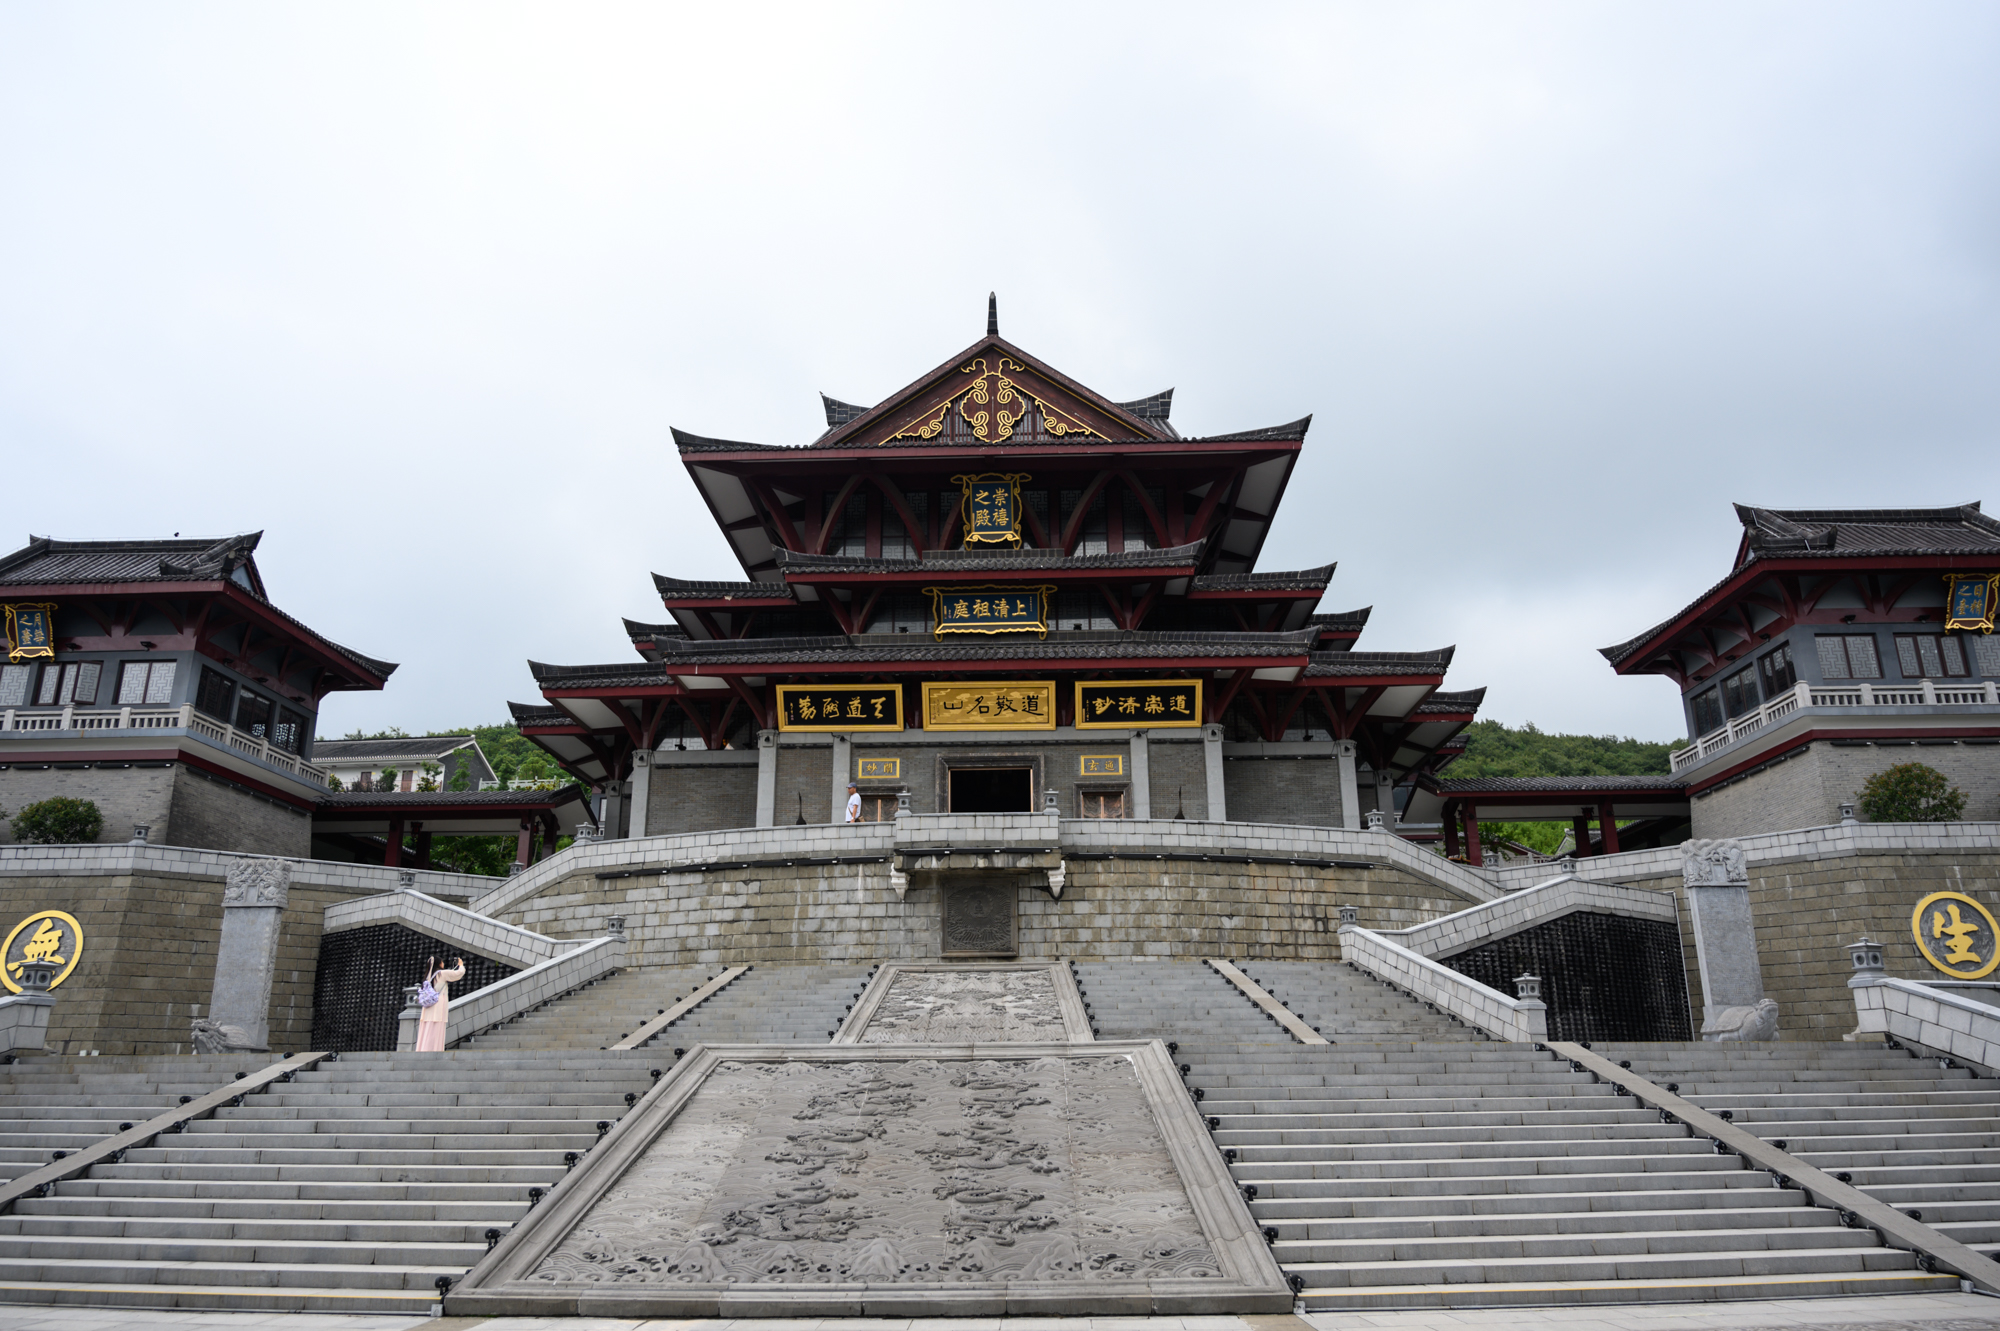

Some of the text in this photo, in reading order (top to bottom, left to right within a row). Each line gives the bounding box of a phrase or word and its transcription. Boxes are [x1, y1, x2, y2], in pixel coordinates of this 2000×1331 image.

[974, 489, 992, 527] 之殿
[992, 487, 1009, 527] 崇禧
[953, 598, 1028, 619] 上清祖庭
[798, 695, 887, 720] 天道酬勤
[943, 695, 1045, 717] 道教名山
[1087, 759, 1115, 771] 通玄
[1932, 904, 1982, 964] 生
